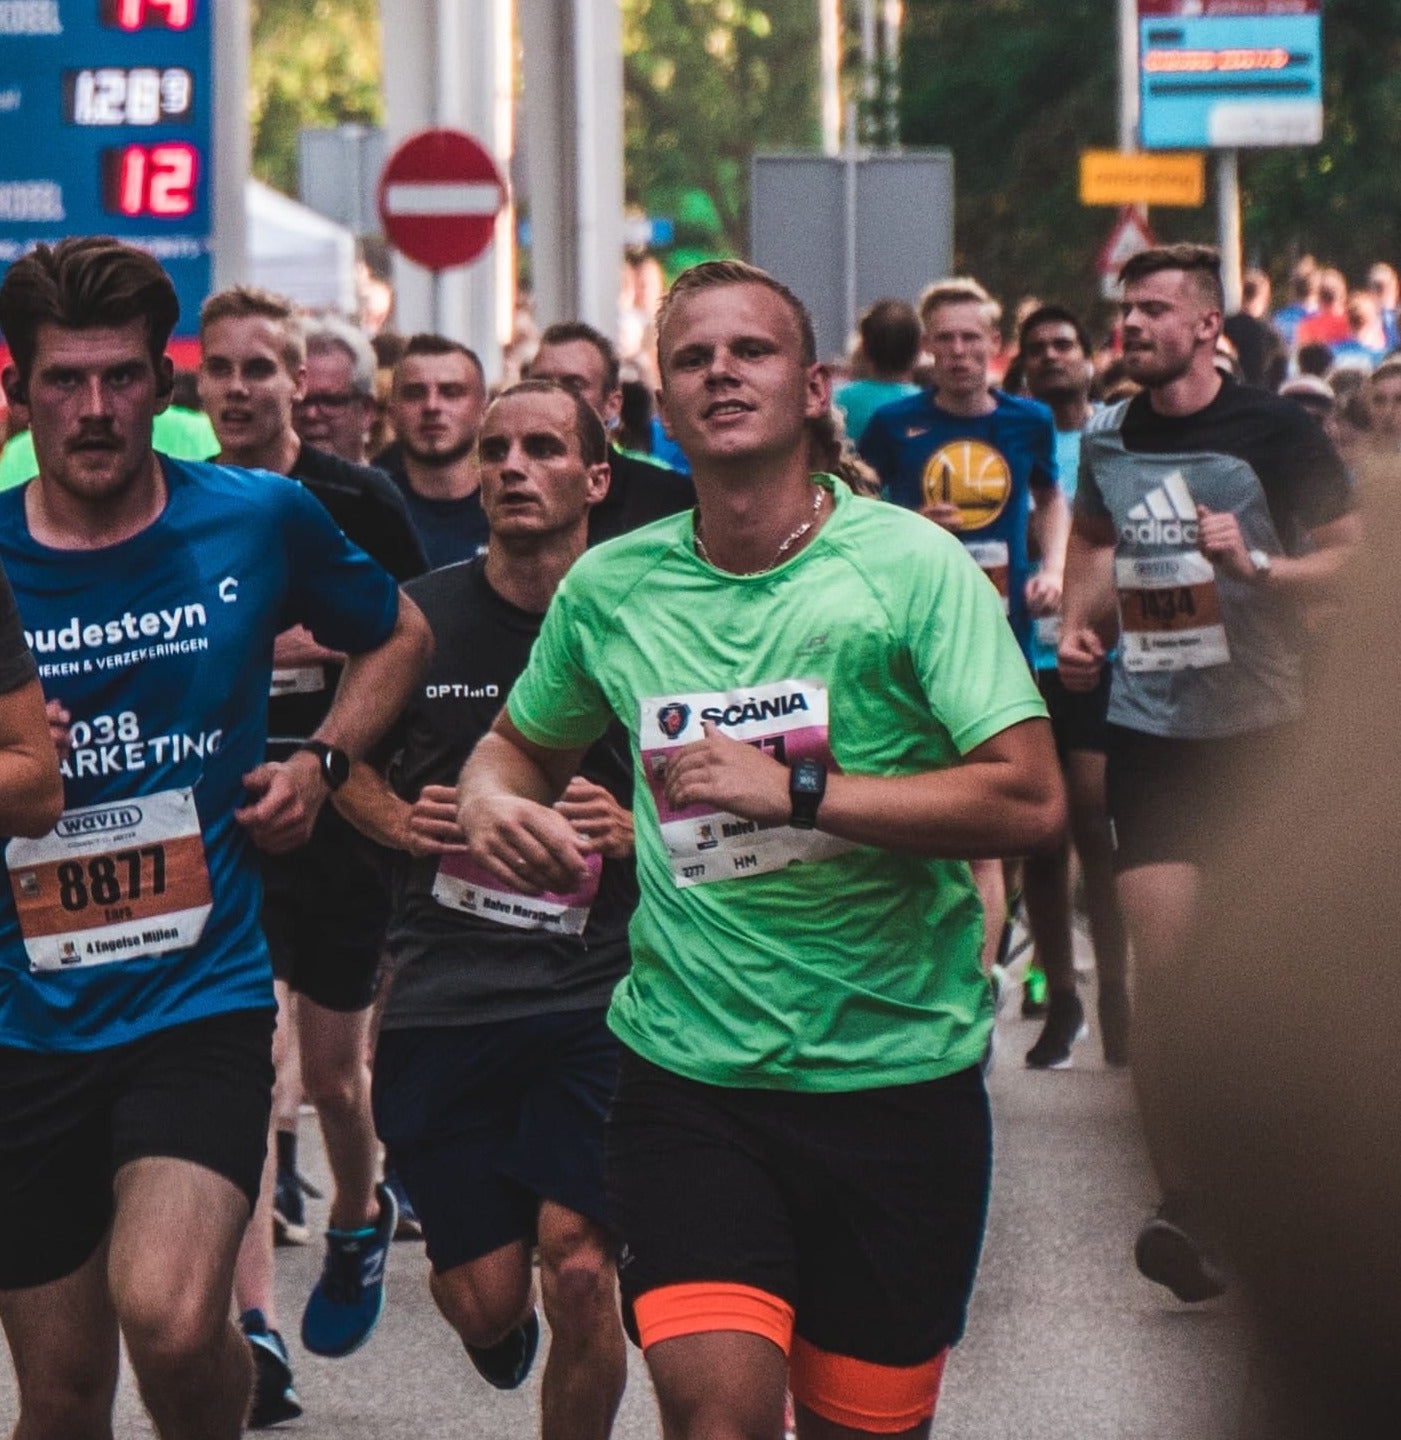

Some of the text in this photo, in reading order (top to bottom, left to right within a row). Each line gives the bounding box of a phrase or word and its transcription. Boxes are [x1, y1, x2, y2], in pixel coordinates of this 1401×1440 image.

[121, 143, 195, 217] 12
[96, 637, 208, 670] VERZEKERINGEN
[63, 811, 133, 833] wavin
[733, 854, 758, 870] HM
[57, 844, 166, 912] 8877
[86, 927, 179, 955] 4 Engelse Mijlen
